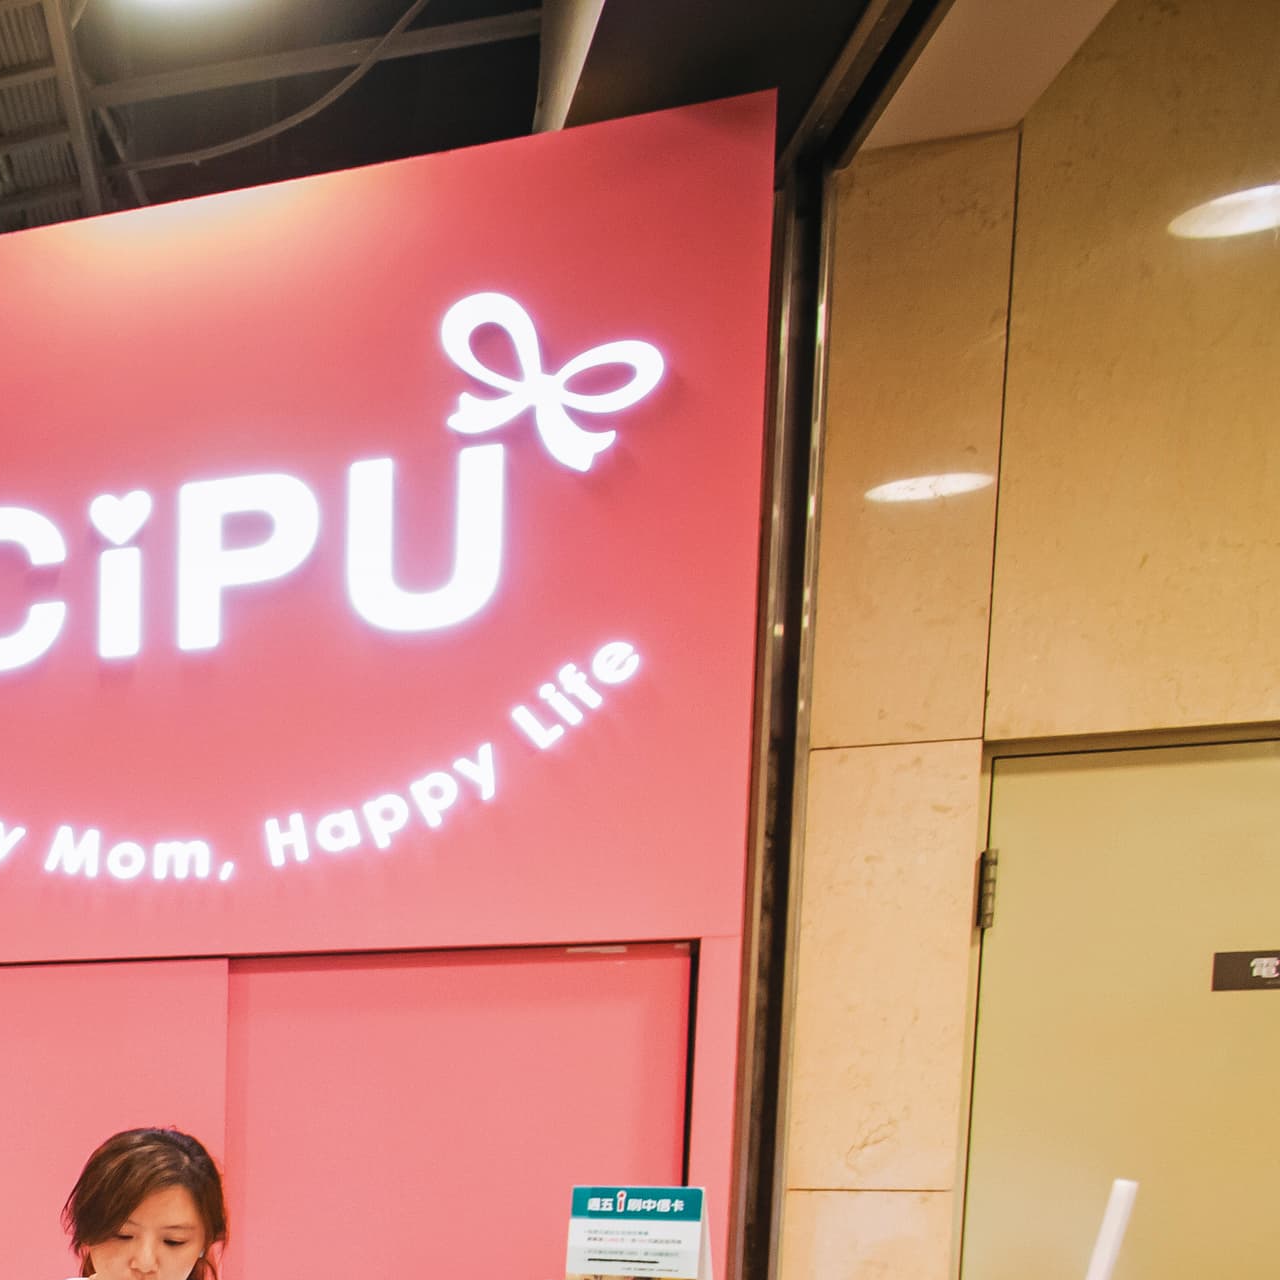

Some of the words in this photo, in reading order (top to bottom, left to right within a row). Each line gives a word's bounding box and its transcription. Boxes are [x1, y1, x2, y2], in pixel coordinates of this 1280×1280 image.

[44, 824, 236, 882] Mom,
[263, 742, 499, 868] Happy
[511, 640, 642, 750] Life
